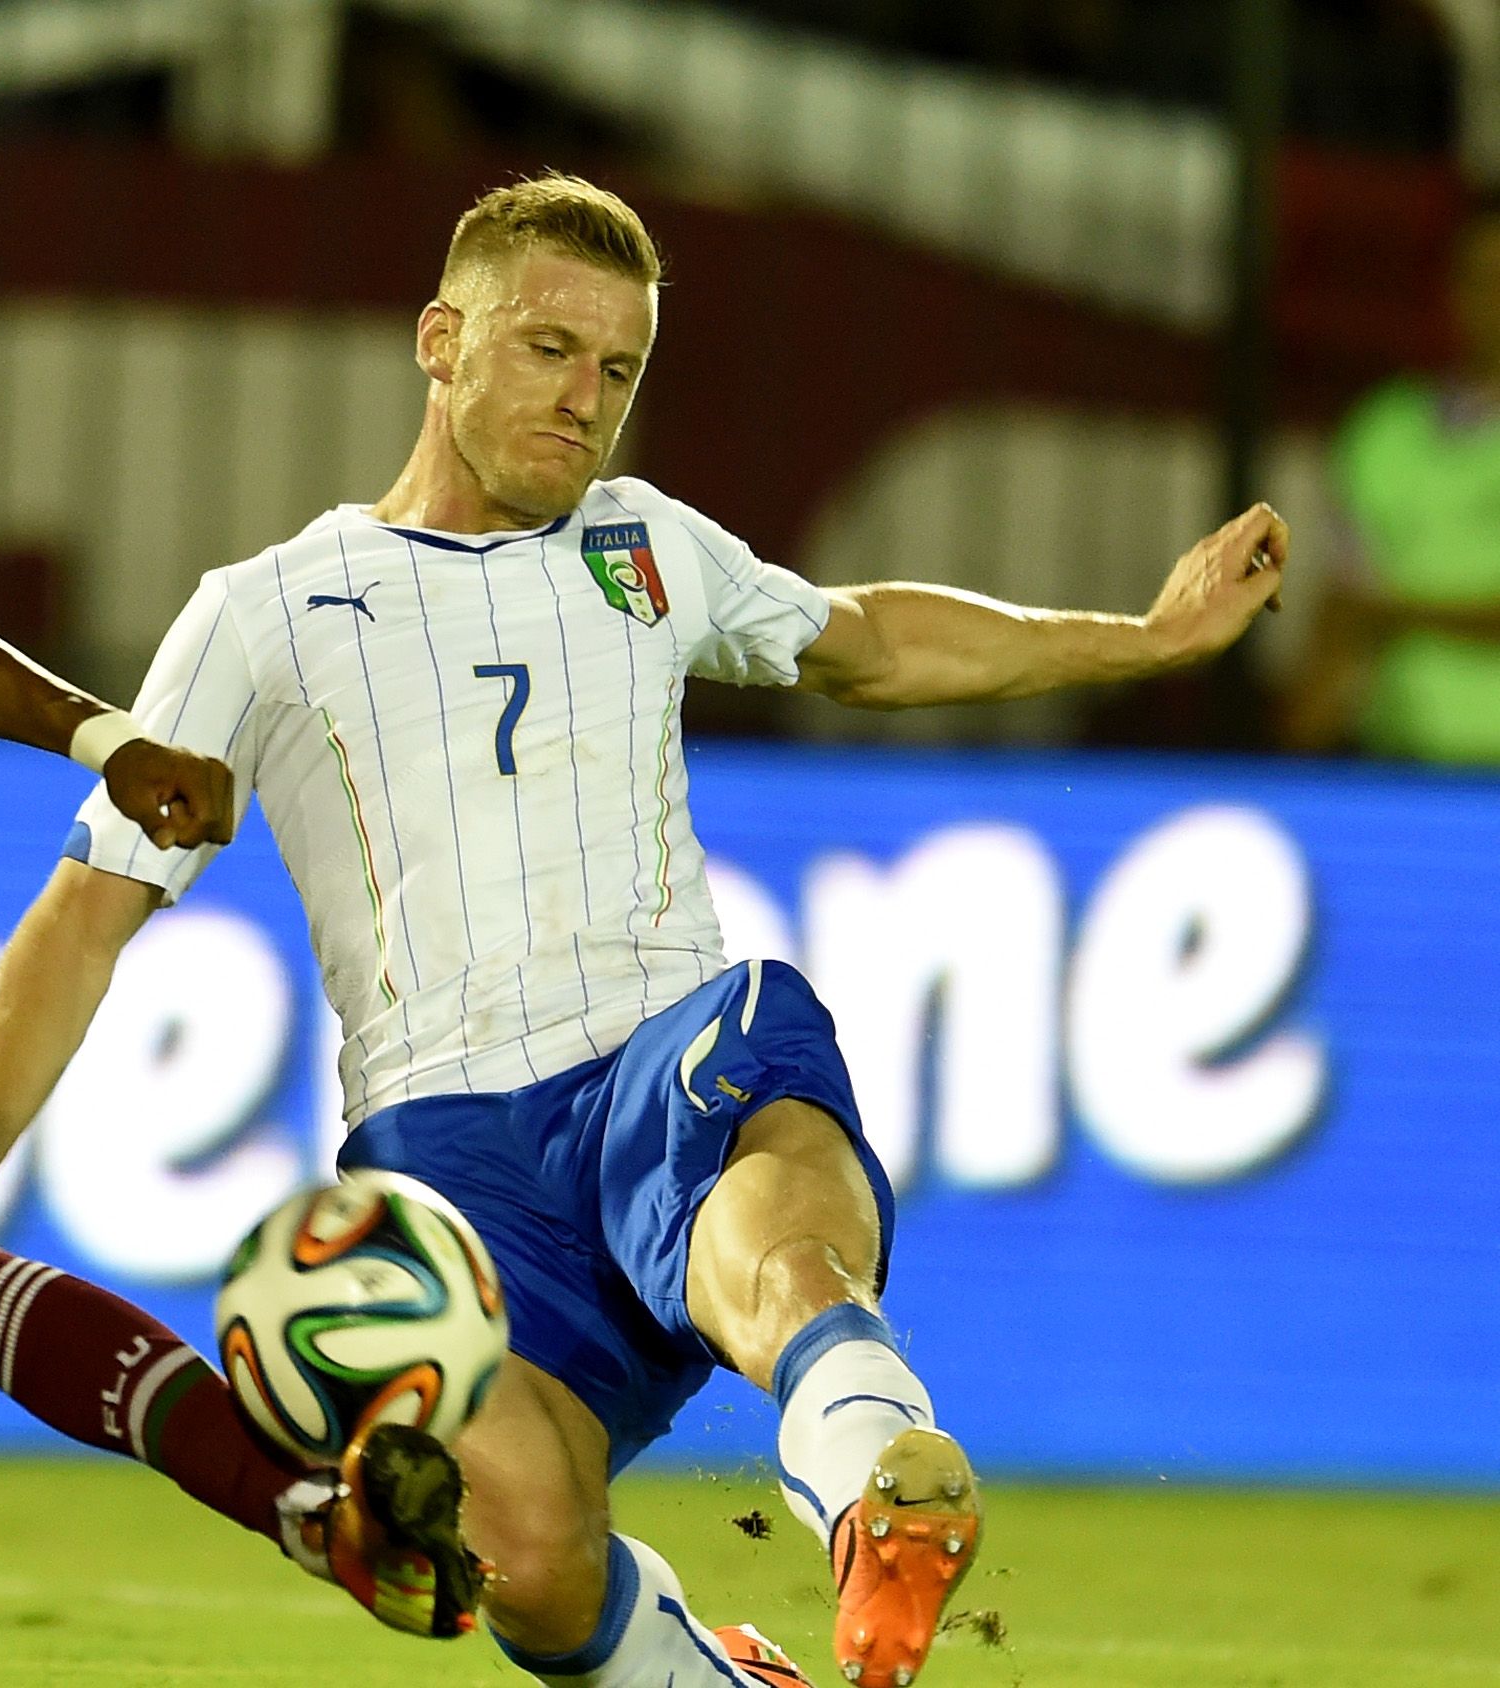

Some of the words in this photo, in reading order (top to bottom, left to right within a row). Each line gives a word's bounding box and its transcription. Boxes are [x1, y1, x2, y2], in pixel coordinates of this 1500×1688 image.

[588, 530, 641, 548] ITALIA
[473, 664, 531, 776] 7
[101, 1335, 151, 1439] FLU
